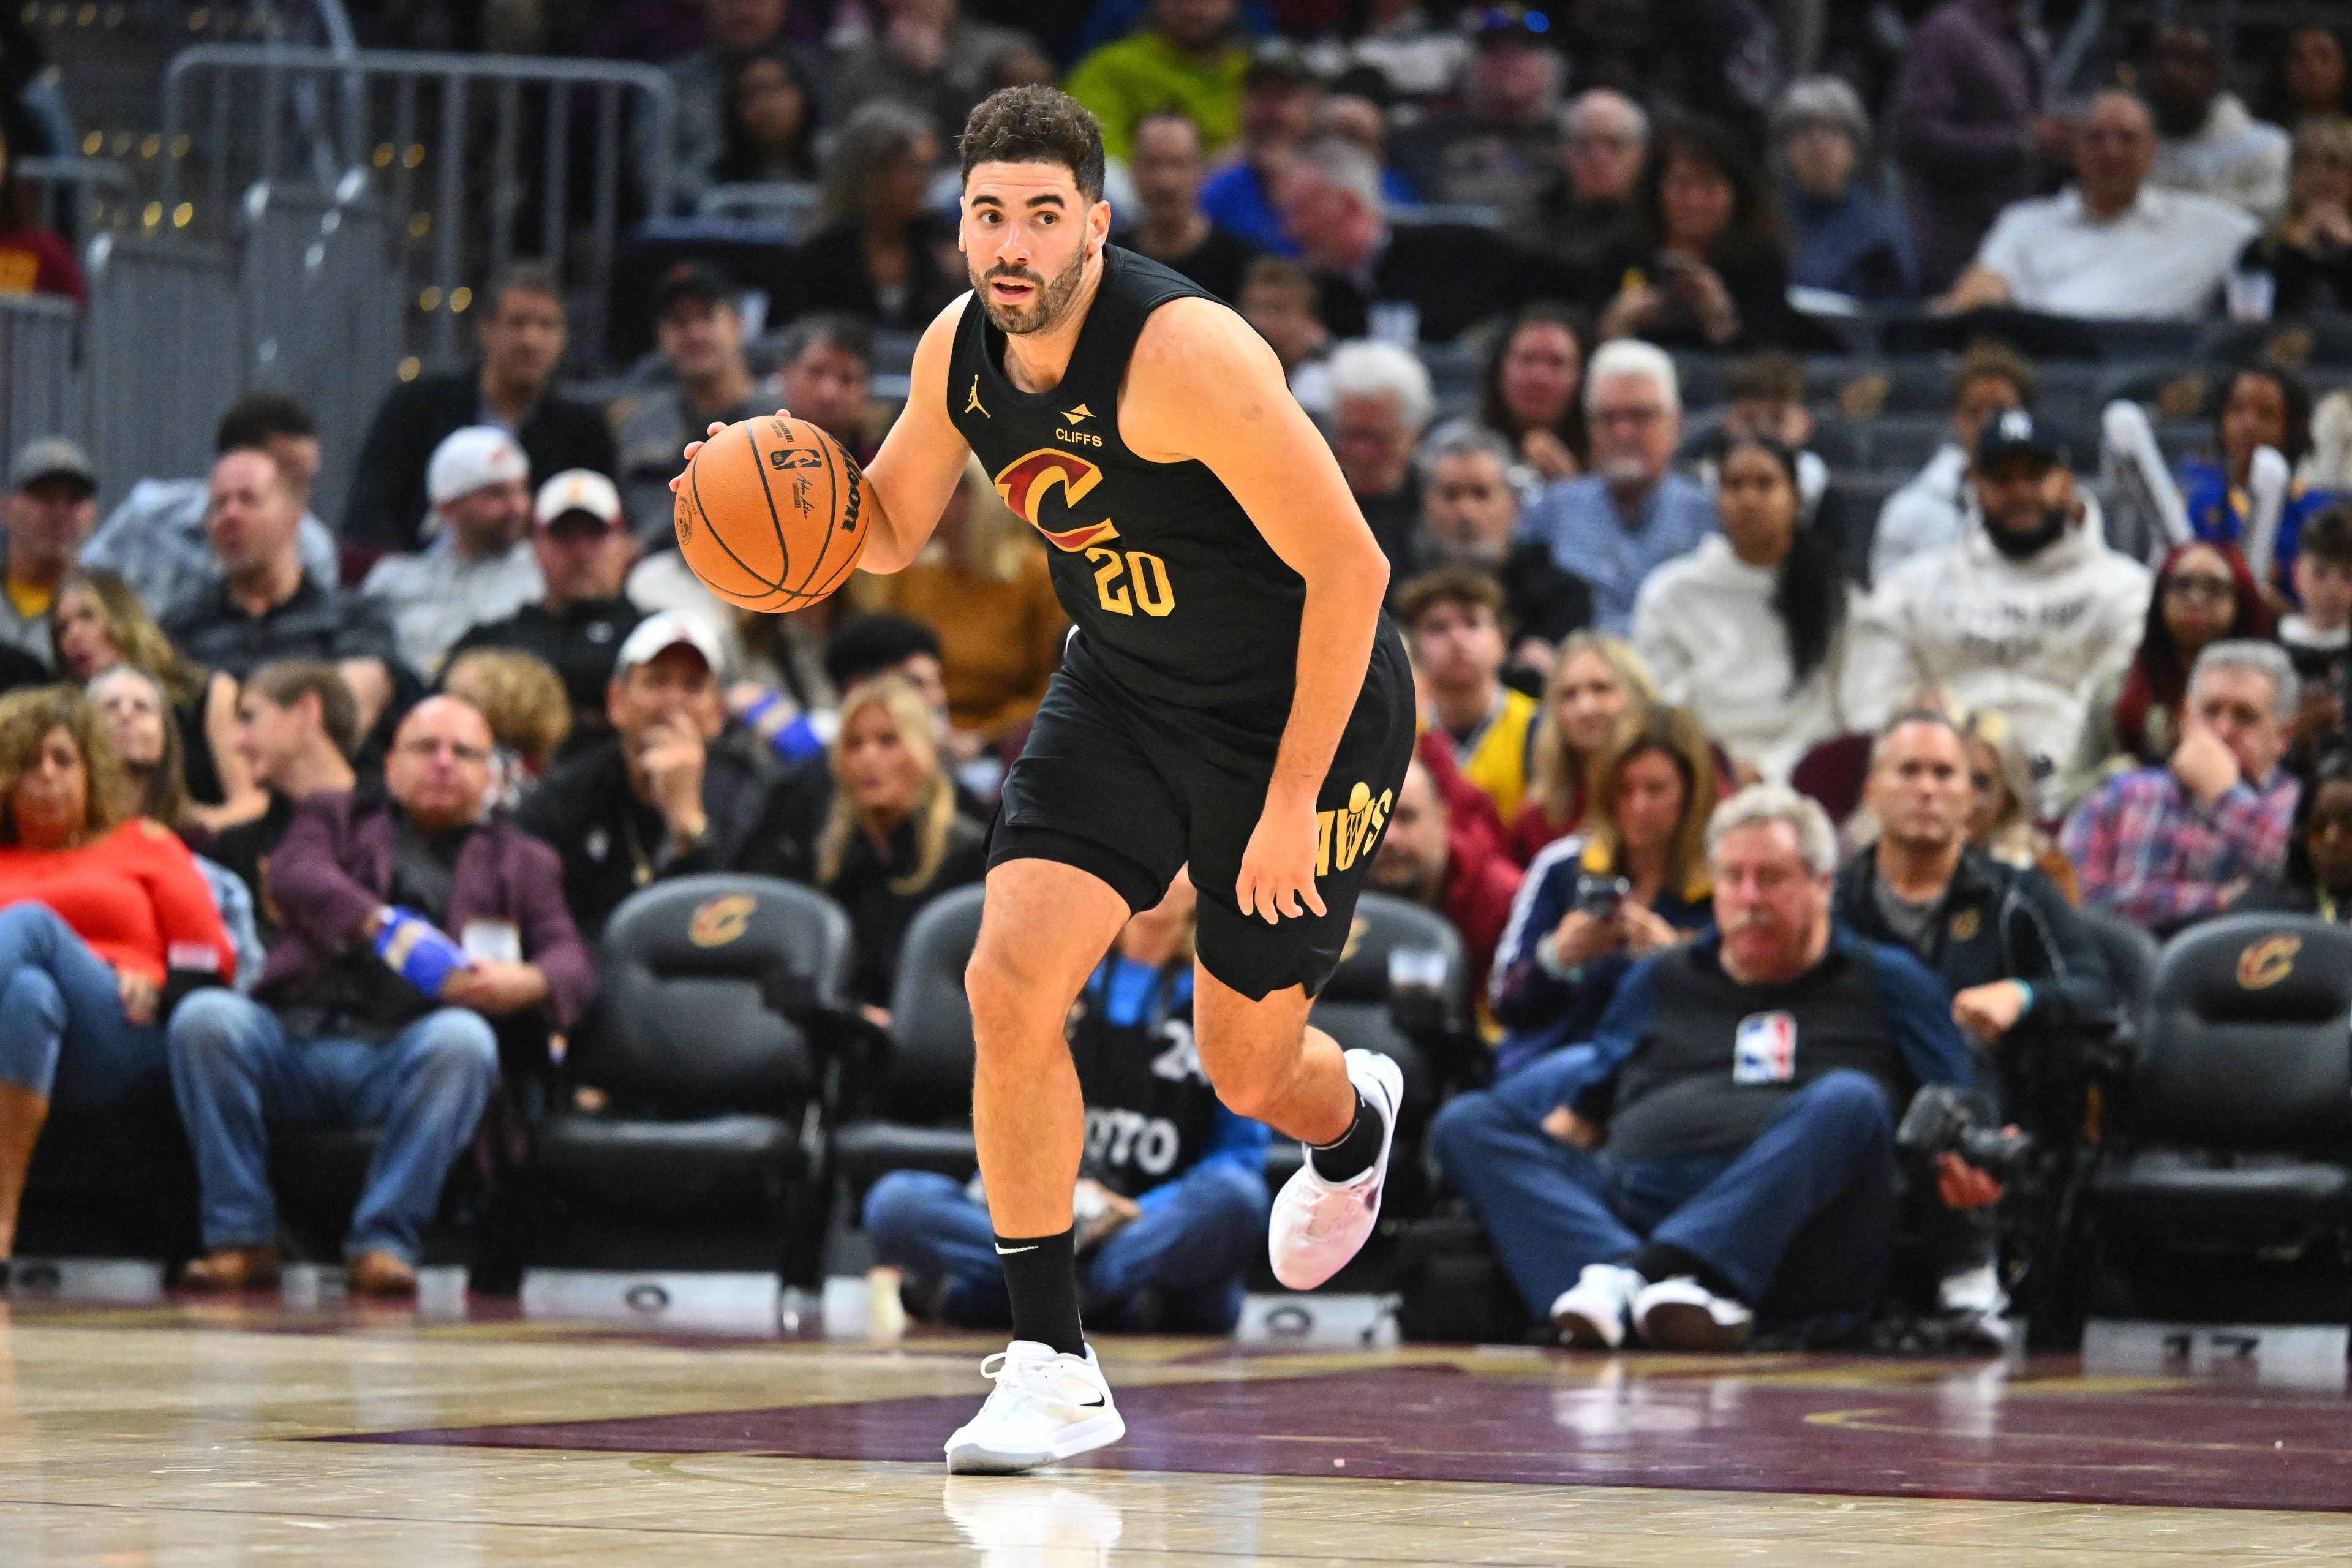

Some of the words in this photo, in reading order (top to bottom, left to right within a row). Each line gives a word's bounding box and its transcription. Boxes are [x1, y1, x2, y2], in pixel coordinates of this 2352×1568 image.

[1055, 428, 1103, 447] CLIFFS
[1084, 547, 1175, 617] 20
[1316, 782, 1393, 877] AVS
[1083, 1106, 1178, 1175] OTO
